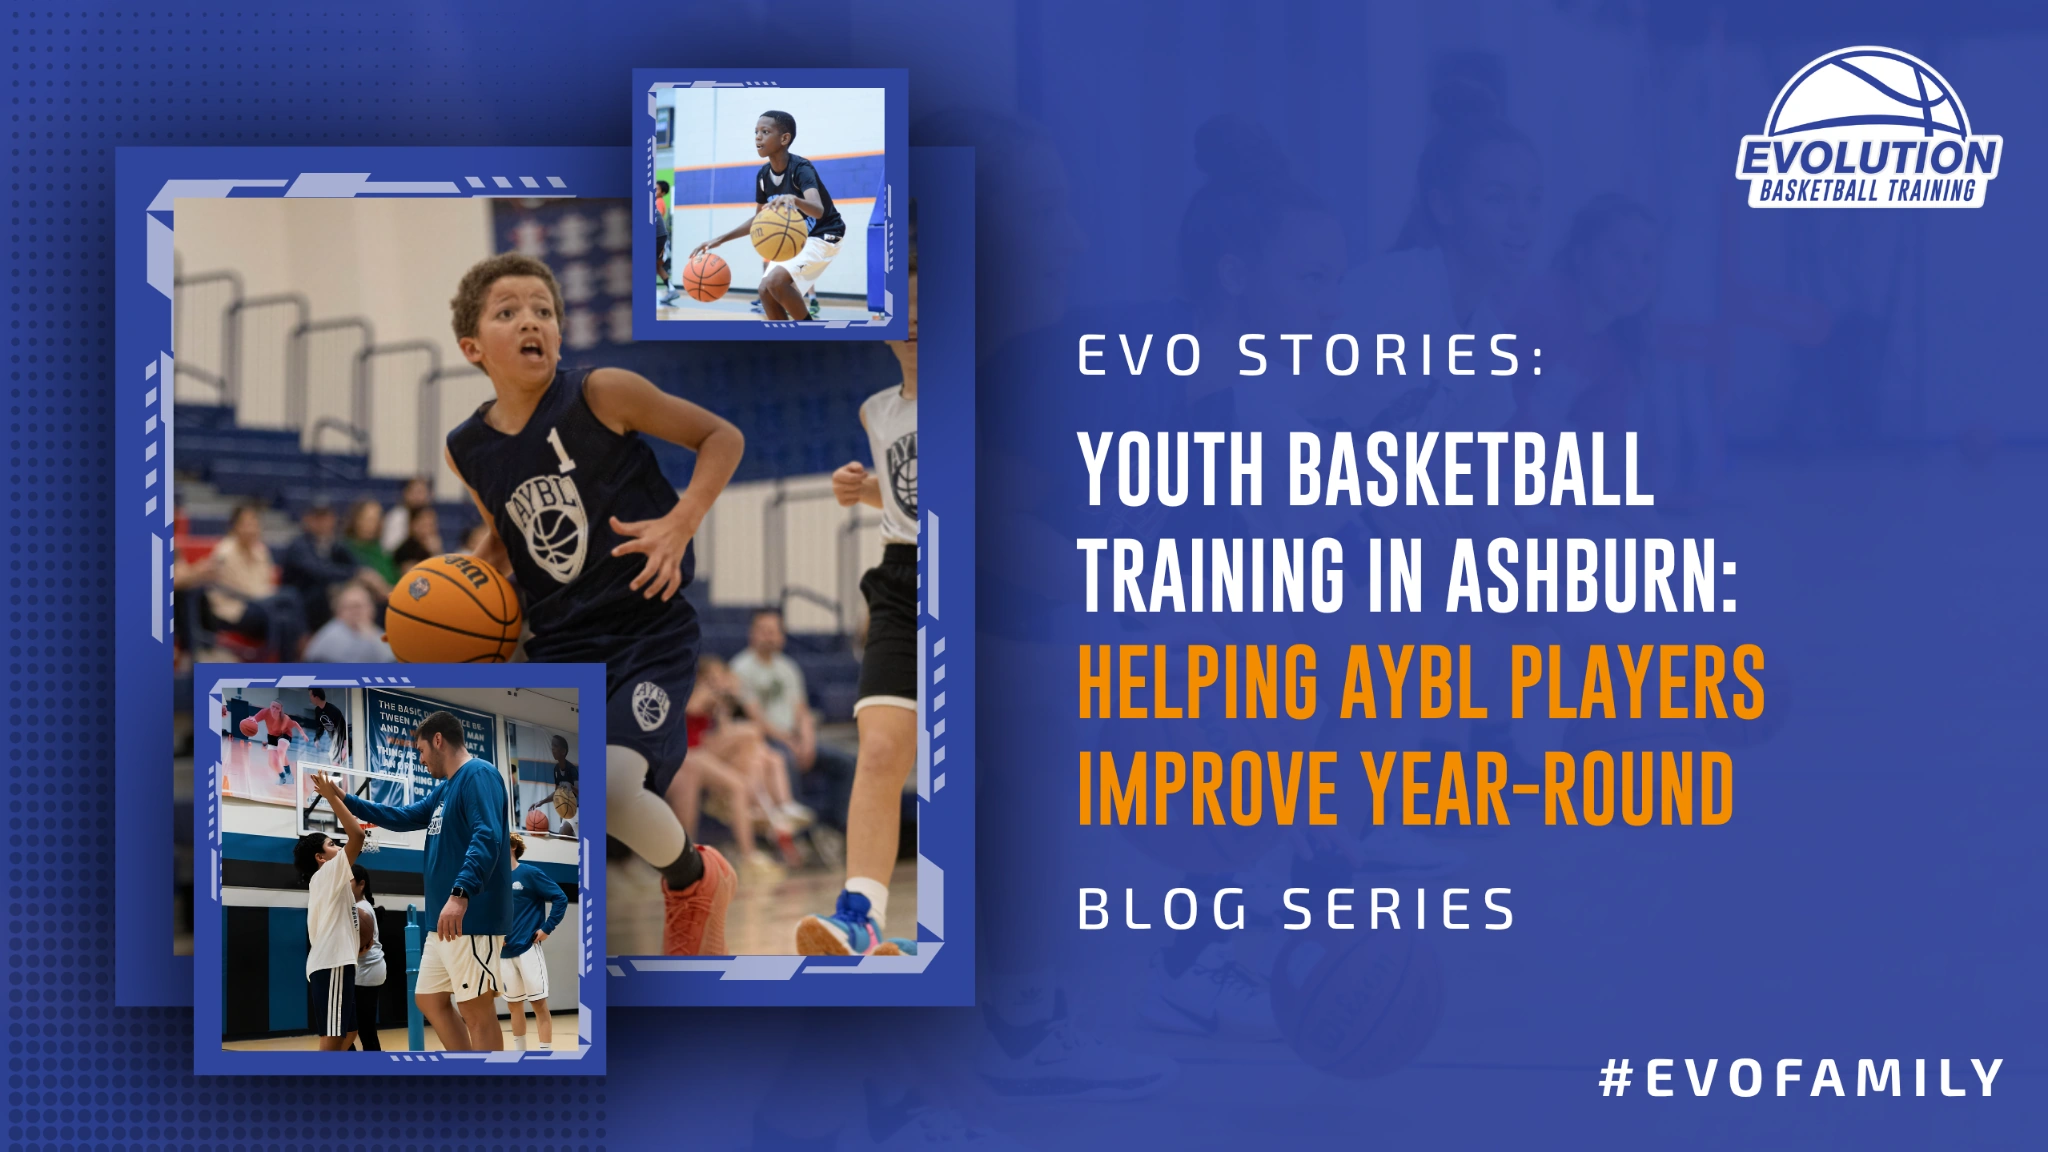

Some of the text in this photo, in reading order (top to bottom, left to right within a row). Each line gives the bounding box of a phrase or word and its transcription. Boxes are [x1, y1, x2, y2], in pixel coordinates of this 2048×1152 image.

[546, 427, 577, 474] 1
[511, 478, 577, 529] AYBL
[379, 700, 396, 711] THE
[398, 704, 422, 717] BASIC
[380, 711, 410, 726] TWEEN
[380, 723, 399, 735] AND
[401, 727, 407, 737] A
